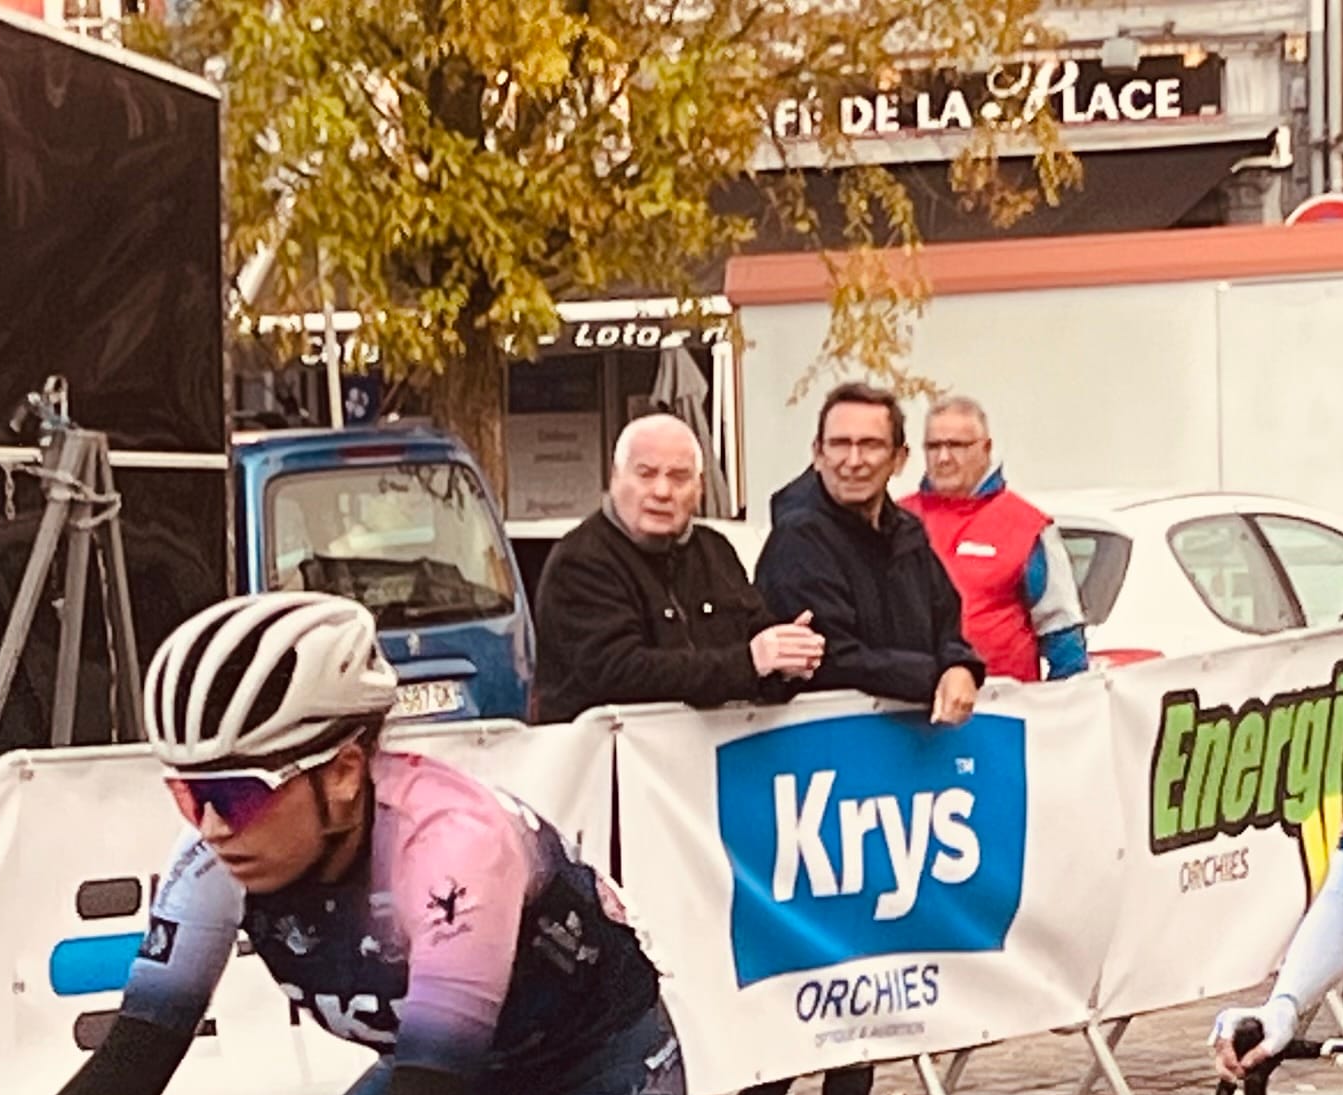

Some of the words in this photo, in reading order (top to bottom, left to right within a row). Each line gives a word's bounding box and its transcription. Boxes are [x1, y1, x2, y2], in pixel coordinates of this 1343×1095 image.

[841, 95, 900, 134] DE
[917, 89, 973, 130] LA
[986, 60, 1181, 124] PLACE
[574, 323, 661, 348] Loto
[771, 769, 981, 921] Krys
[1179, 847, 1250, 894] ORCHIES
[795, 963, 940, 1022] ORCHIES
